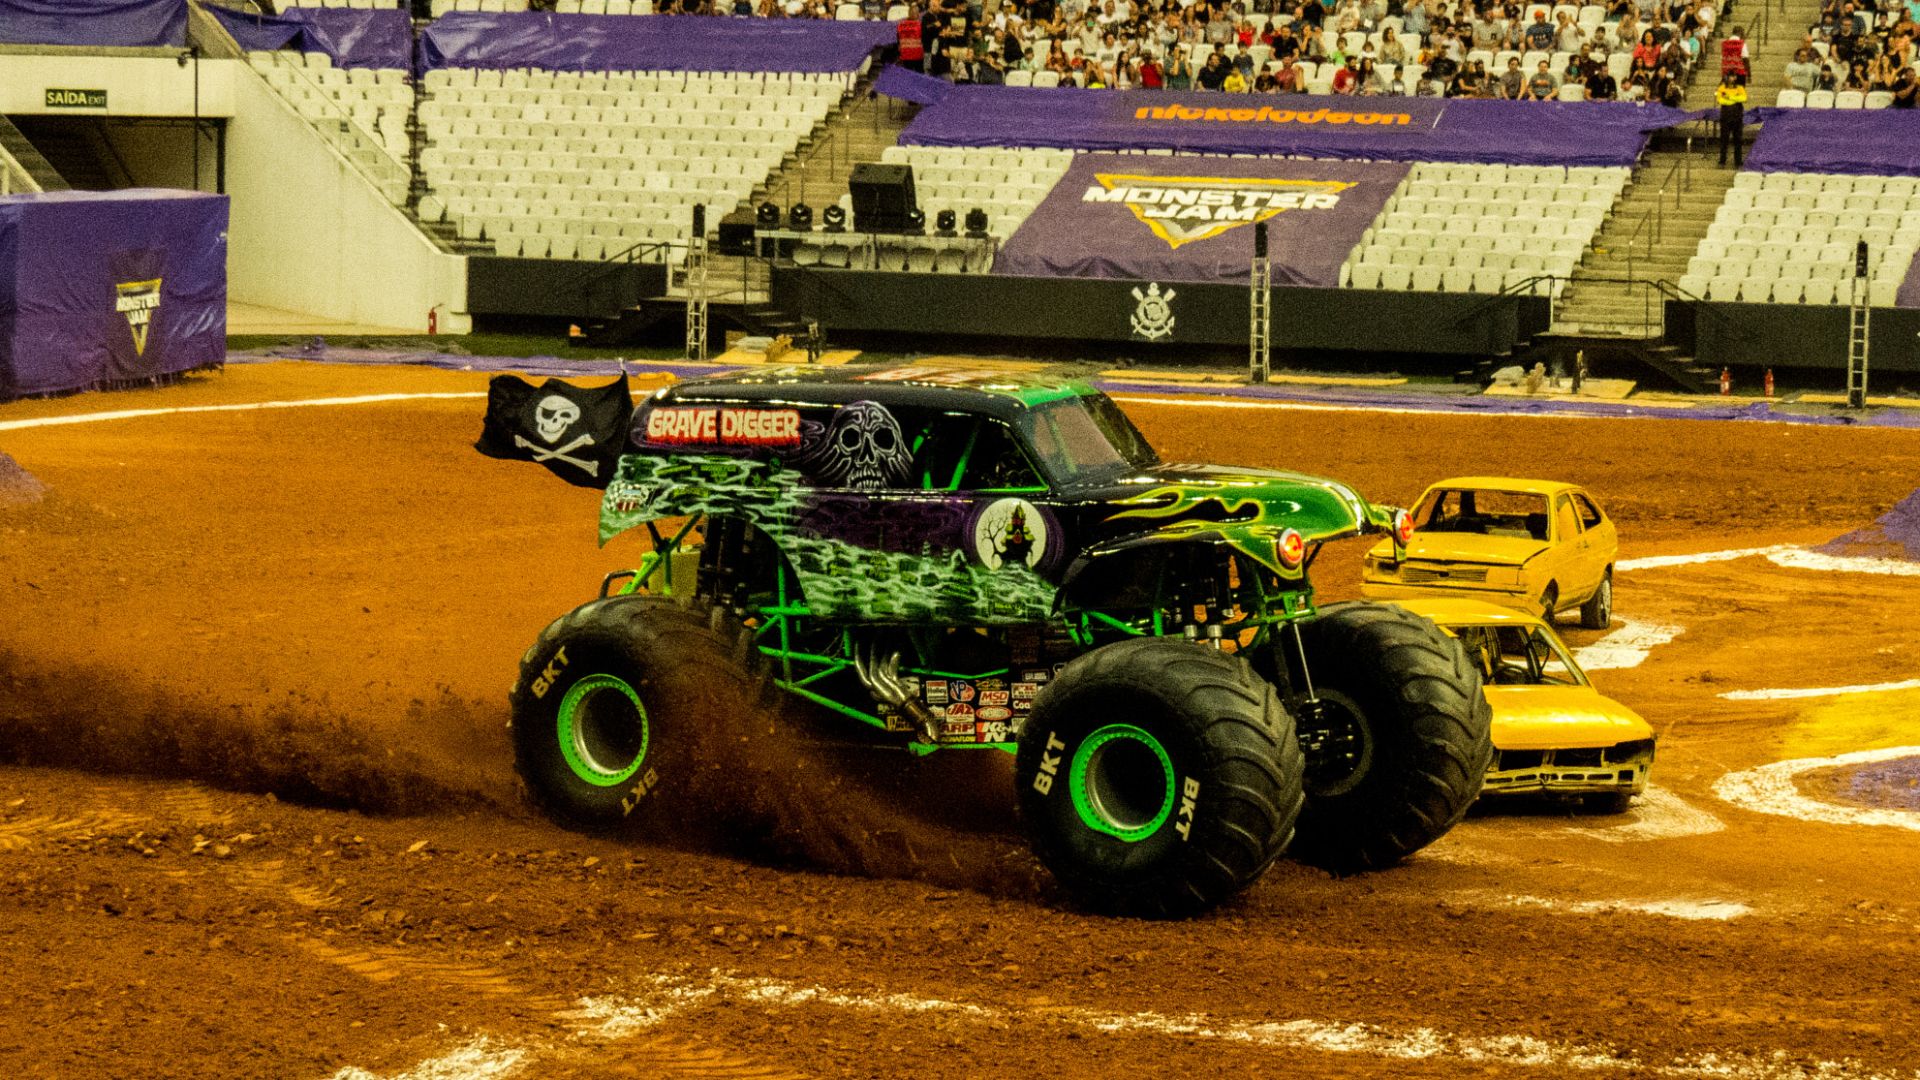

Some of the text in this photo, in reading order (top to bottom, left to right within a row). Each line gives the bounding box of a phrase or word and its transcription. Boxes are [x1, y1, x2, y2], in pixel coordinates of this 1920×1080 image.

[47, 91, 105, 105] SAÍDA EXIT
[1135, 104, 1411, 125] nickelodeon
[1082, 186, 1340, 210] MONSTER
[1144, 205, 1258, 222] JAM
[648, 408, 799, 438] GRAVE DIGGER
[531, 645, 569, 698] BKT
[981, 691, 1008, 700] MSD
[1033, 731, 1066, 796] BKT
[621, 767, 659, 817] BKT
[1175, 776, 1200, 842] BKT
